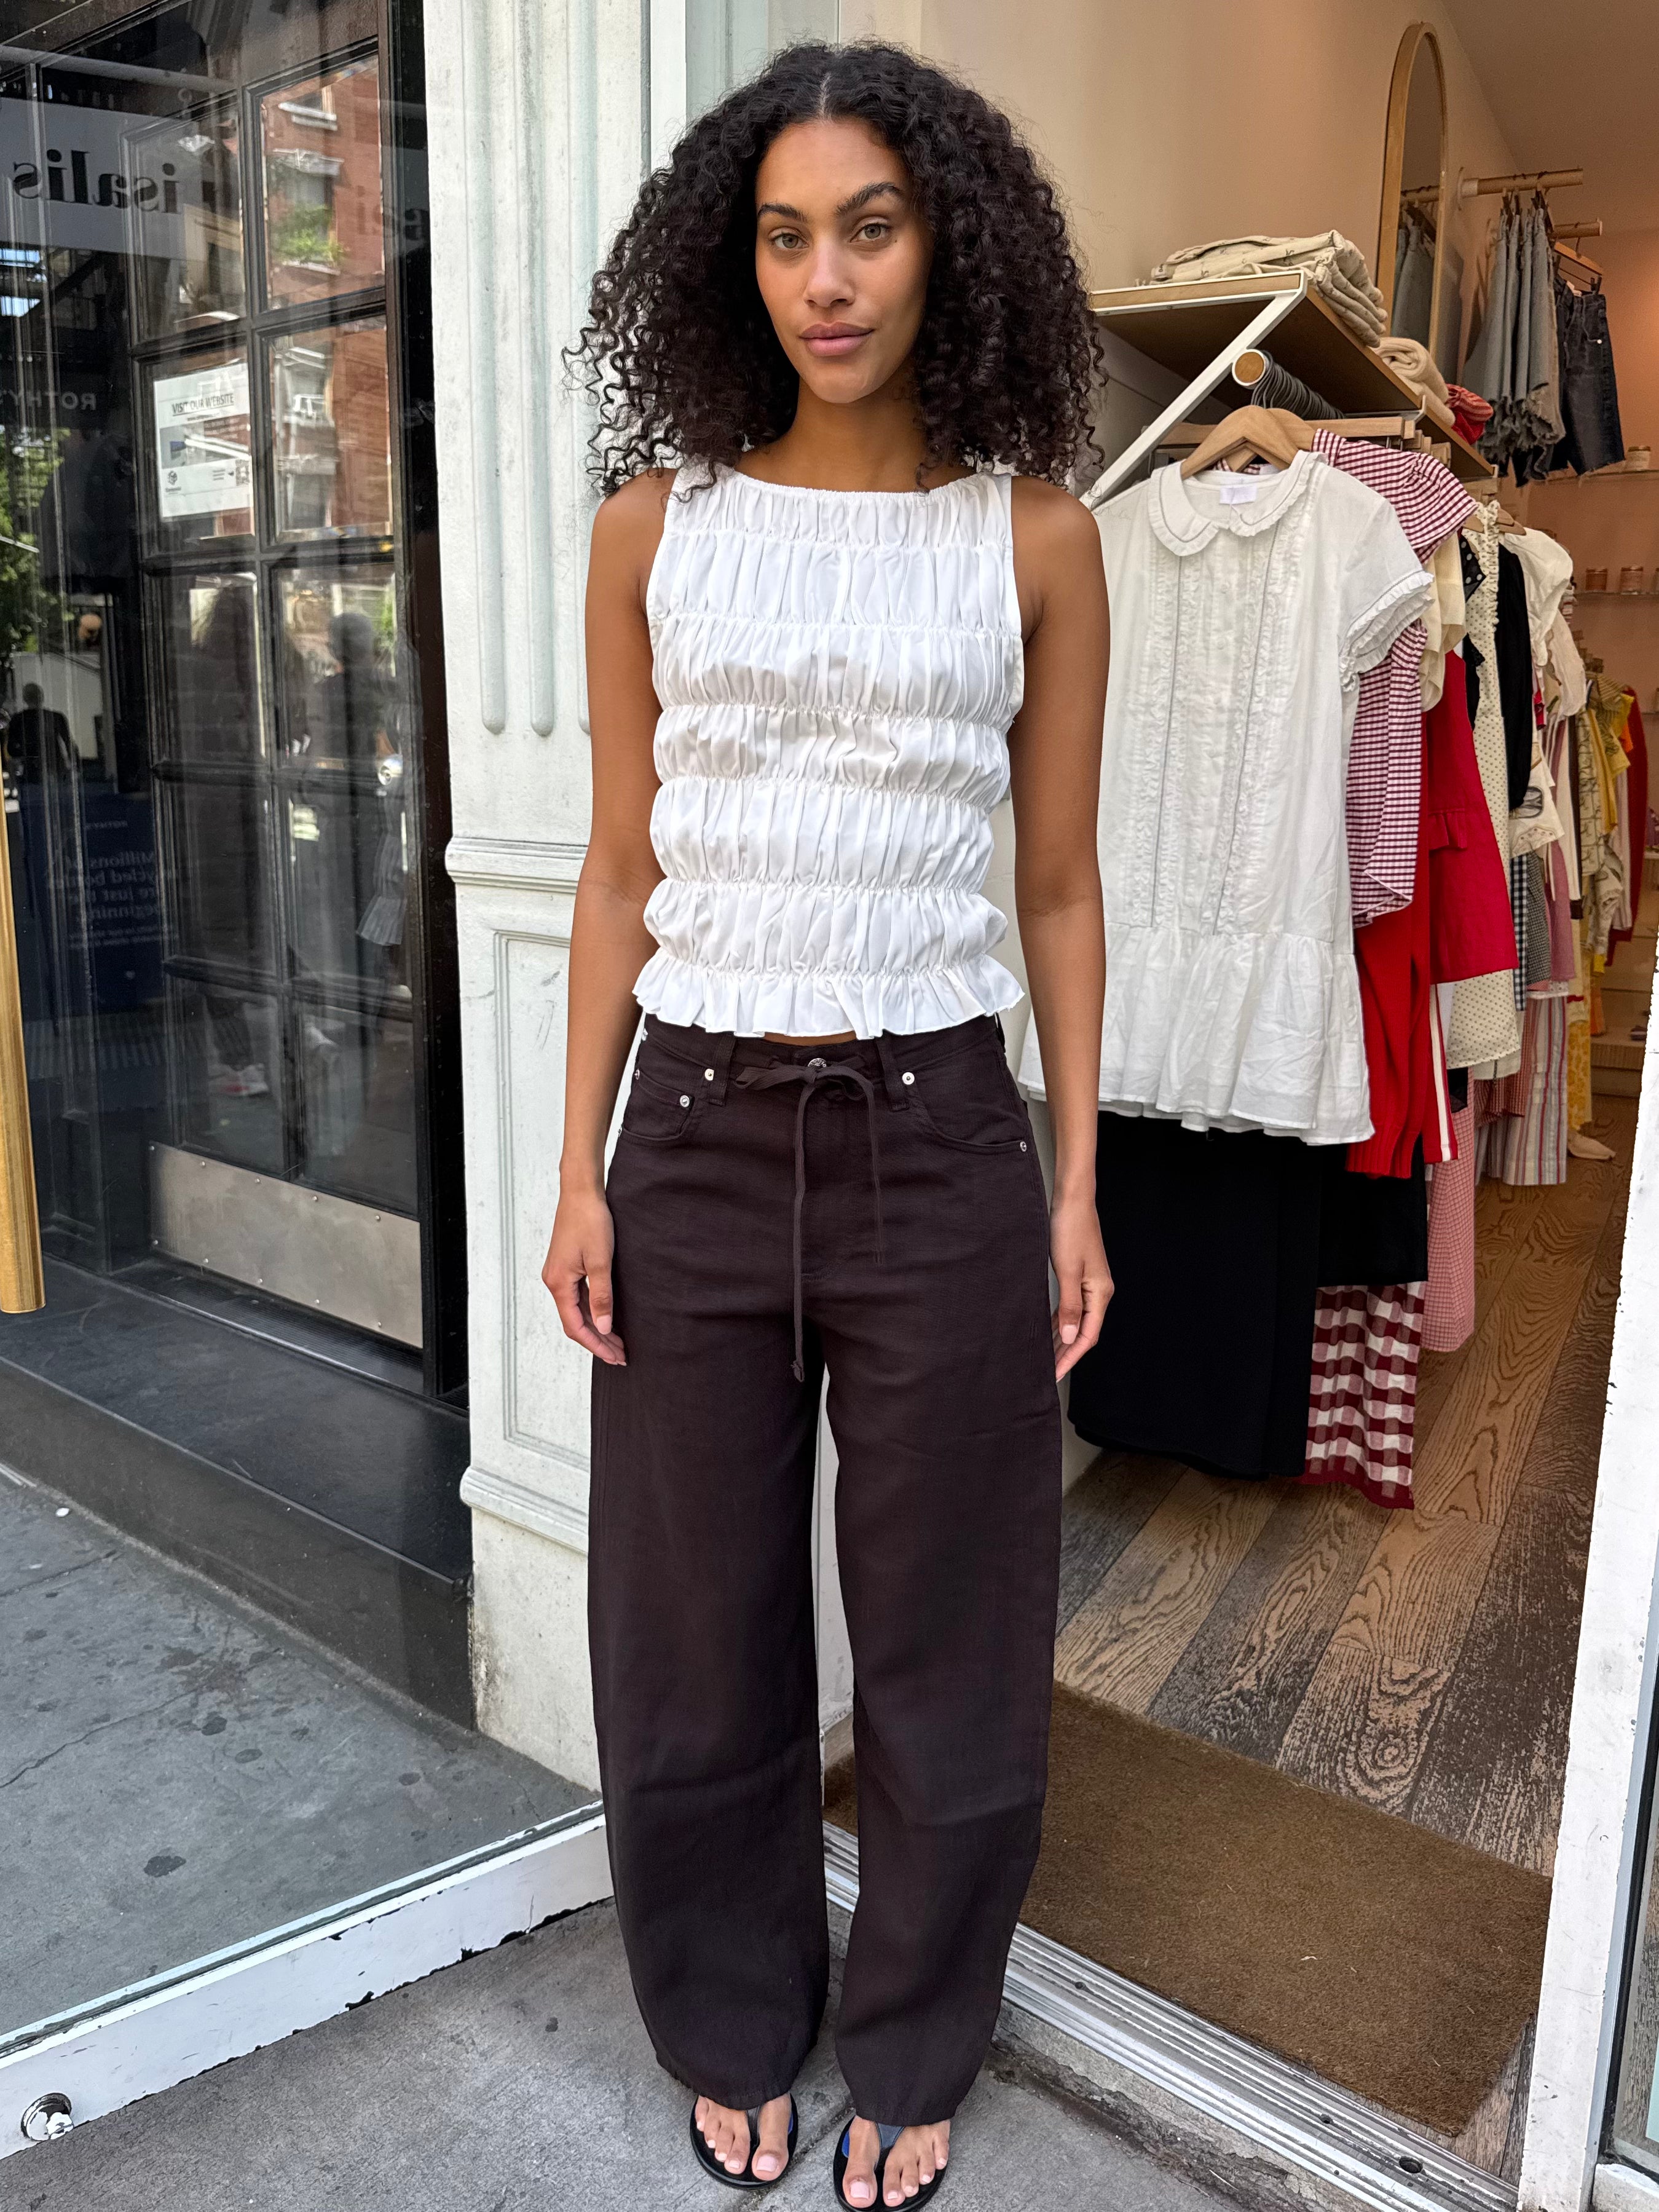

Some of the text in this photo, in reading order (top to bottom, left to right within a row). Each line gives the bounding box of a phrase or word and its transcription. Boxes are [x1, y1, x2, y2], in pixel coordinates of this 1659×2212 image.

[172, 393, 234, 414] VISIT OUR WEBSITE
